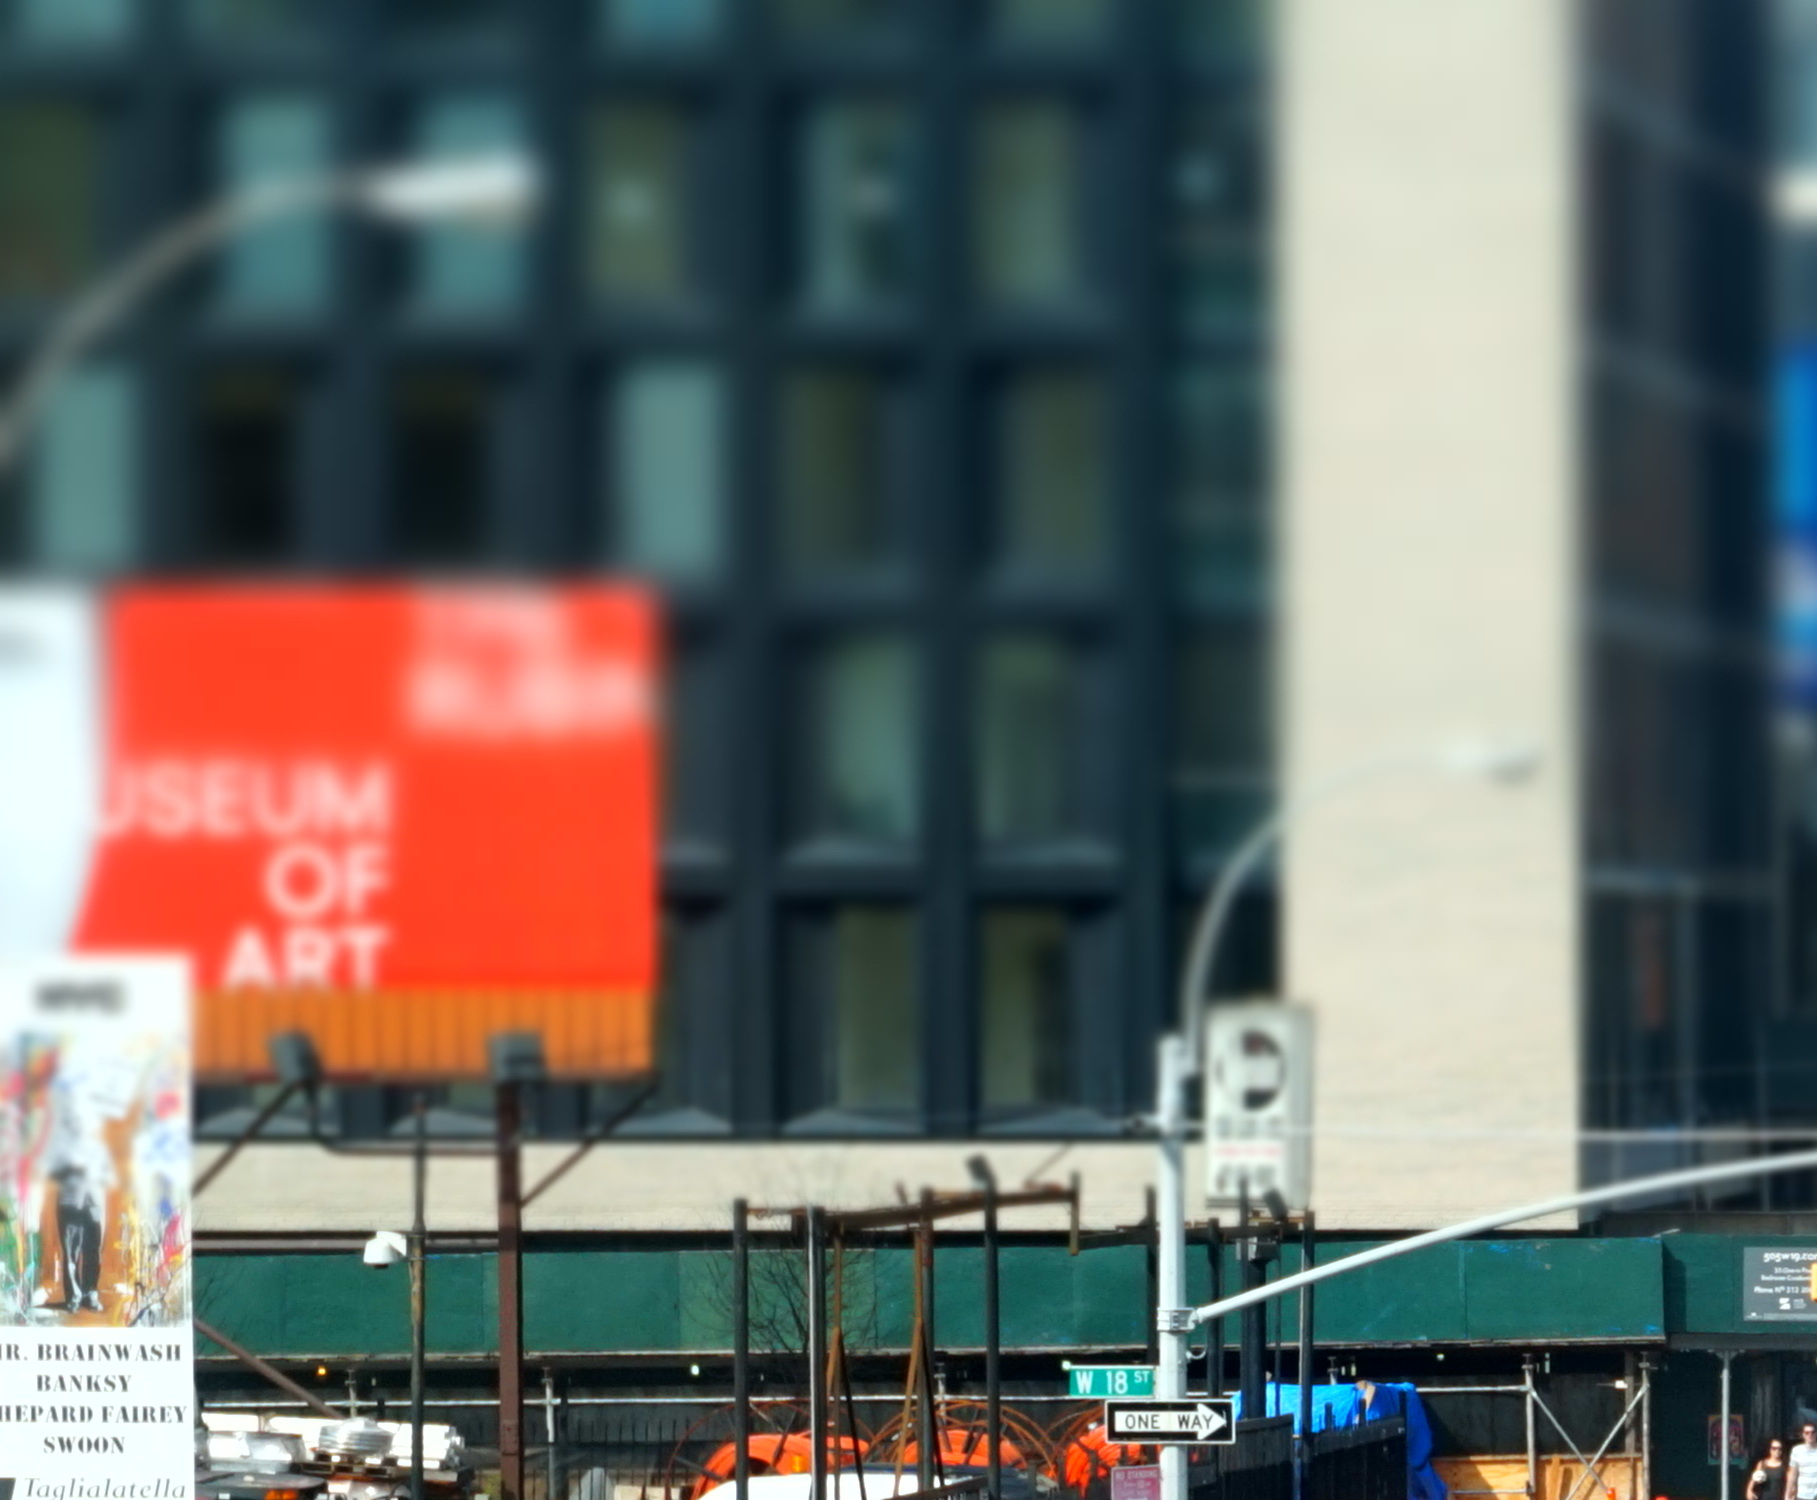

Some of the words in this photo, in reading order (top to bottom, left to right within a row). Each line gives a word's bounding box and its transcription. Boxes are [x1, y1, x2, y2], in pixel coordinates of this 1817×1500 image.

[97, 763, 393, 838] USEUM
[264, 842, 393, 920] OF
[224, 926, 394, 988] ART
[37, 1344, 181, 1361] BRAINWASH
[37, 1375, 132, 1392] BANKSY
[1075, 1371, 1093, 1394] W
[1106, 1371, 1128, 1394] 18
[1134, 1371, 1150, 1383] ST
[0, 1405, 93, 1423] HEPARD
[101, 1406, 187, 1423] FAIREY
[1125, 1414, 1161, 1429] ONE
[1177, 1414, 1214, 1429] WAY
[43, 1436, 125, 1454] SWOON
